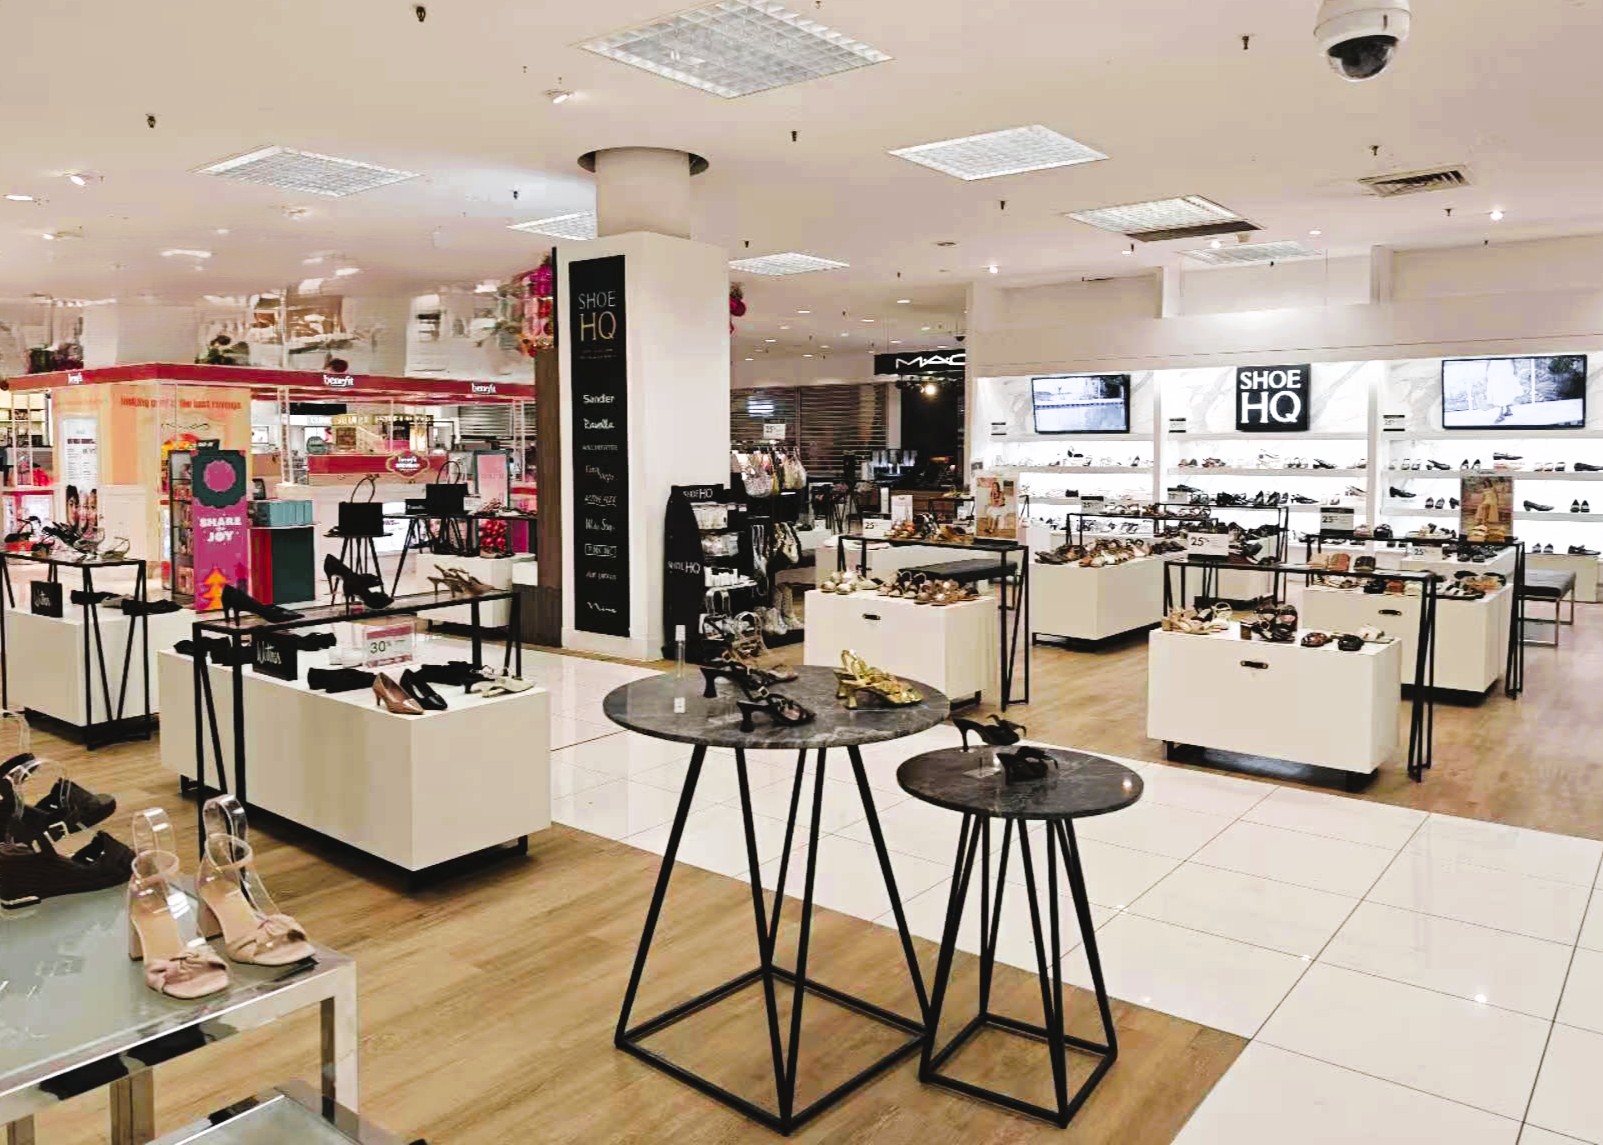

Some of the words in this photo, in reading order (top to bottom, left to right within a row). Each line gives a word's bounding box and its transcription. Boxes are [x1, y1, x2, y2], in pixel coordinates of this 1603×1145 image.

[578, 291, 616, 309] SHOE
[580, 311, 617, 341] HQ
[323, 375, 354, 387] benefit
[1240, 369, 1301, 390] SHOE
[1240, 390, 1302, 424] HQ
[699, 488, 713, 499] HQ
[199, 516, 242, 528] SHARE
[207, 530, 234, 542] JOY
[685, 561, 701, 574] HQ
